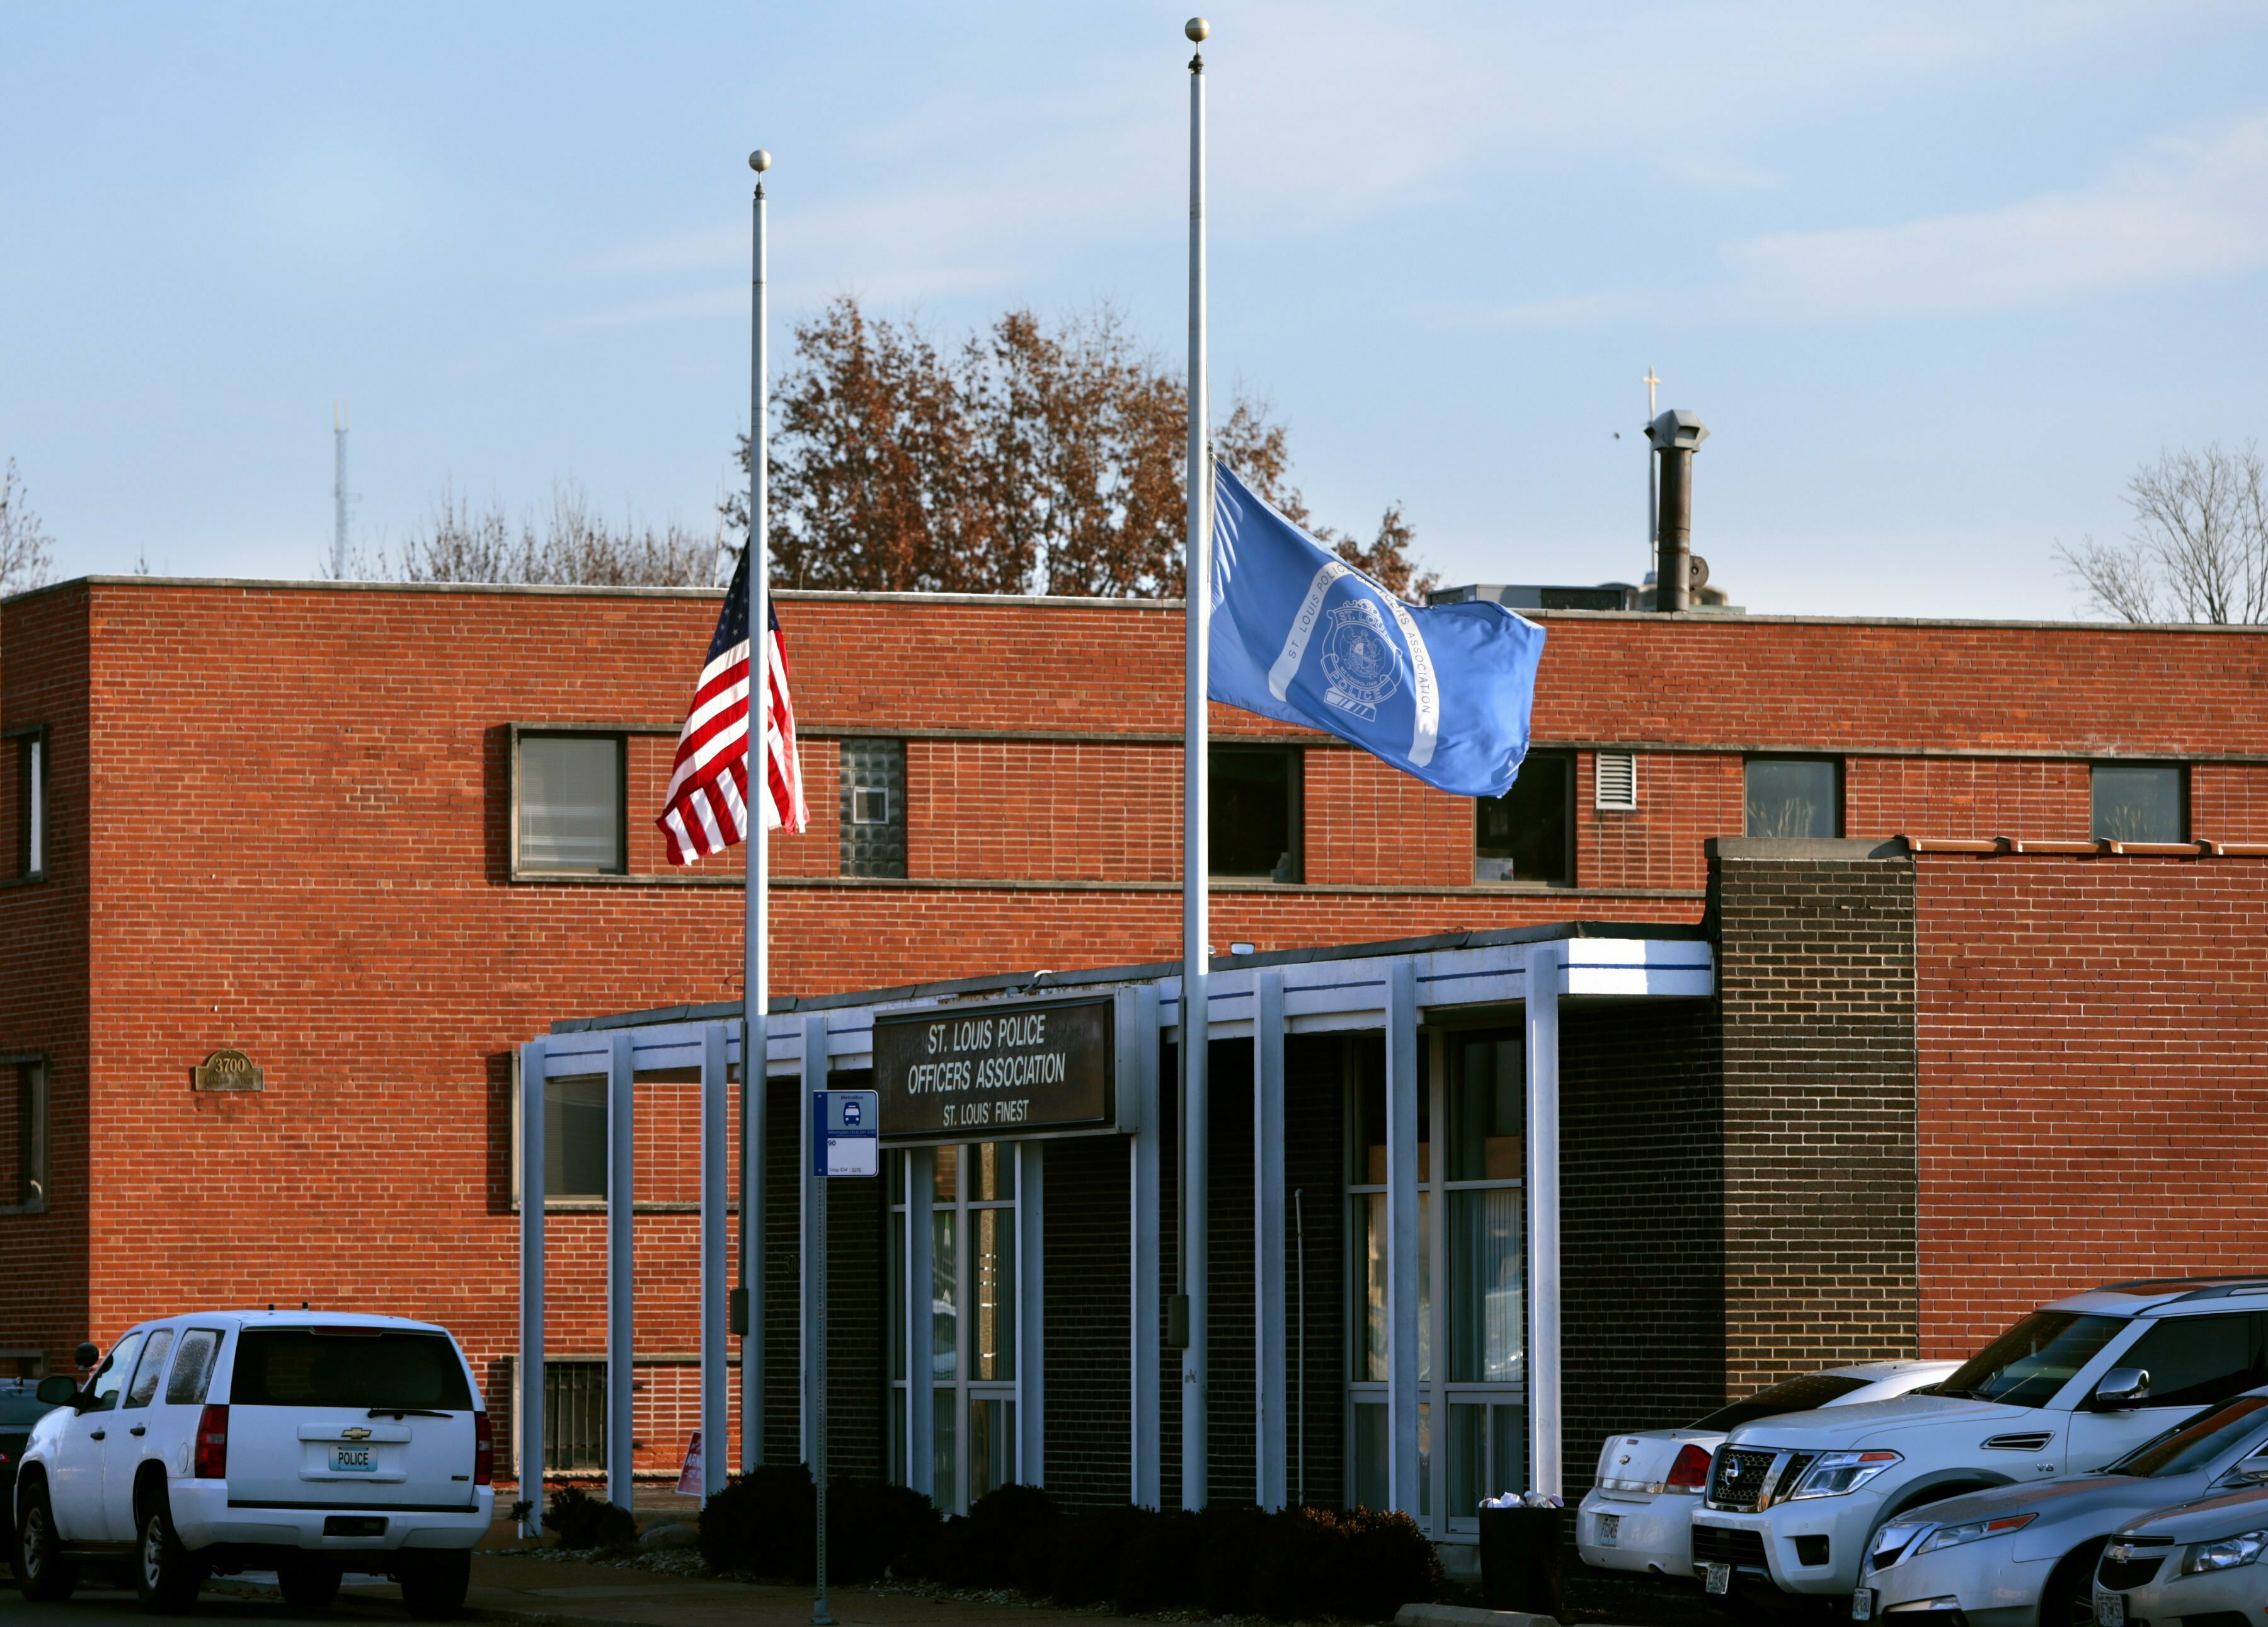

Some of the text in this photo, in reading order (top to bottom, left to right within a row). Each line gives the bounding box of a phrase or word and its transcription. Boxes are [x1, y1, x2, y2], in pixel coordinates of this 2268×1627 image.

[1338, 611, 1355, 621] ST.
[1299, 594, 1320, 633] LOUIS
[1407, 632, 1431, 713] ASSOCIATION
[1329, 669, 1383, 701] POLICE
[1339, 665, 1378, 687] METROPOLITAN
[927, 1014, 1046, 1054] ST. LOUIS POLICE
[215, 1058, 246, 1073] 3700
[908, 1052, 1066, 1095] OFFICERS ASSOCIATION
[943, 1099, 1029, 1127] ST. LOUIS' FINEST
[338, 1452, 369, 1466] POLICE
[2036, 1463, 2054, 1472] V8
